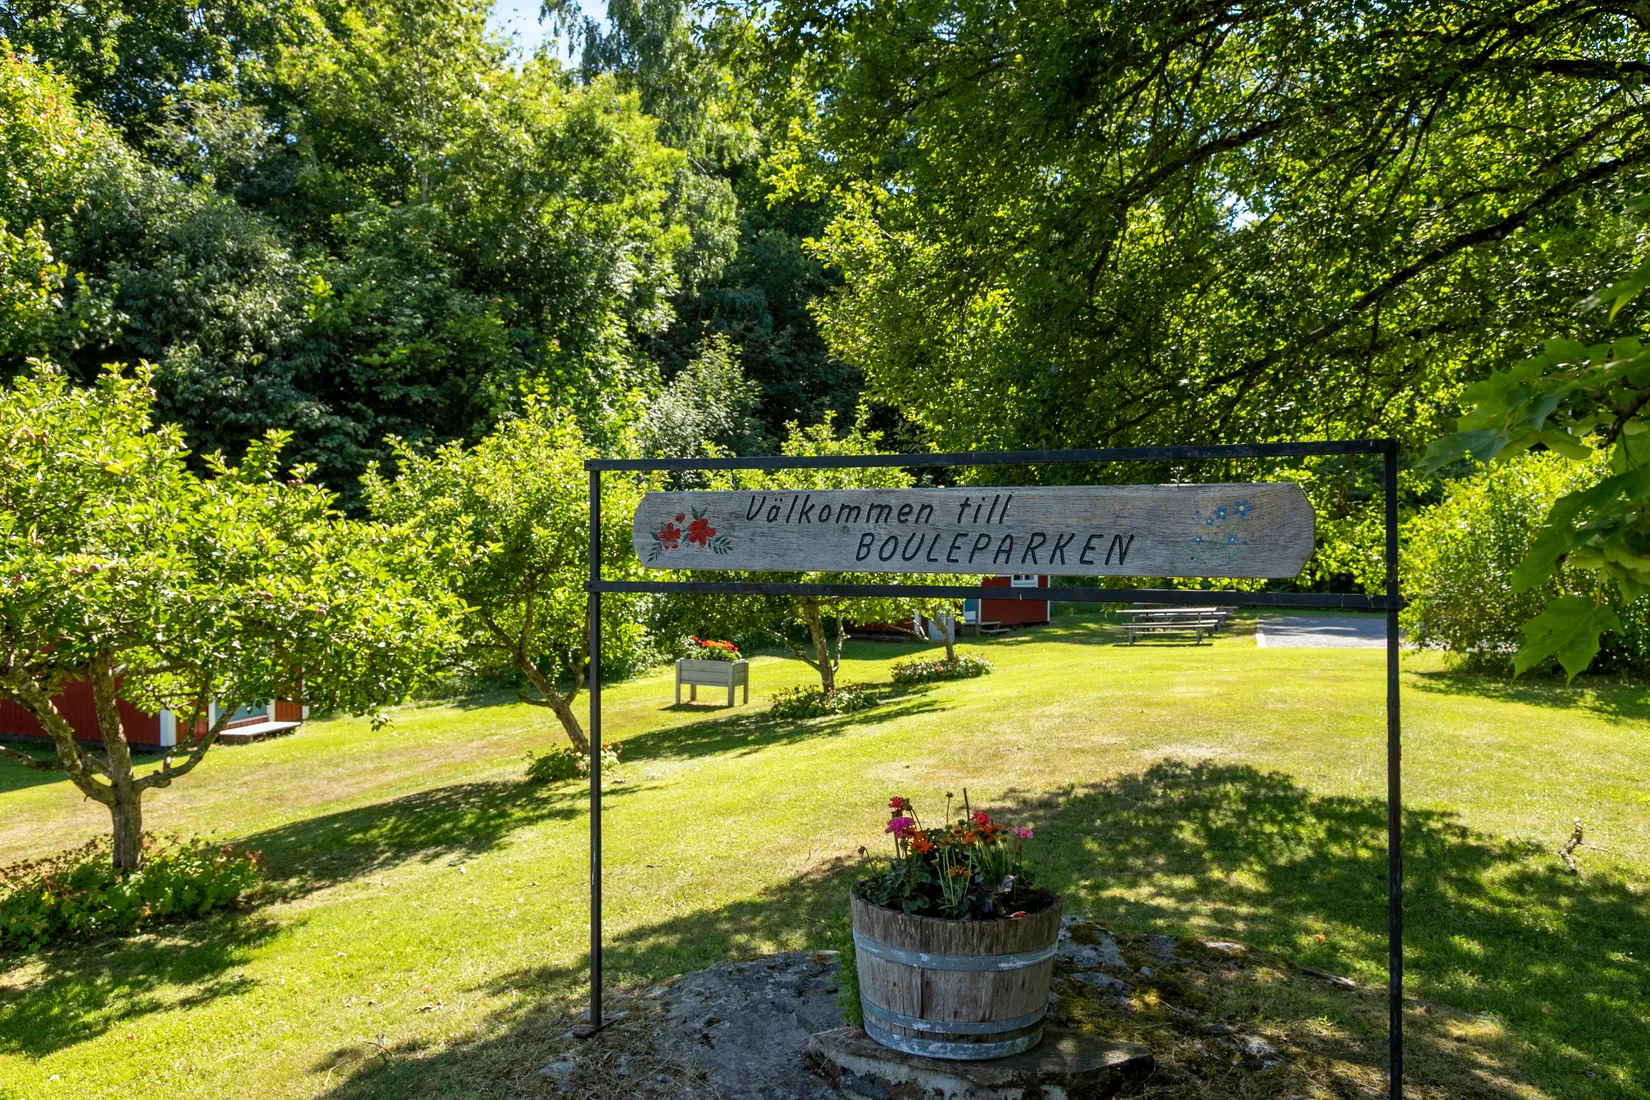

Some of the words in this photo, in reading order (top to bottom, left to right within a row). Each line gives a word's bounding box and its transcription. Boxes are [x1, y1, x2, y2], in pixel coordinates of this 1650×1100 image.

[745, 493, 935, 525] Välkommen
[957, 493, 1013, 525] till
[855, 532, 1135, 566] BOULEPARKEN
